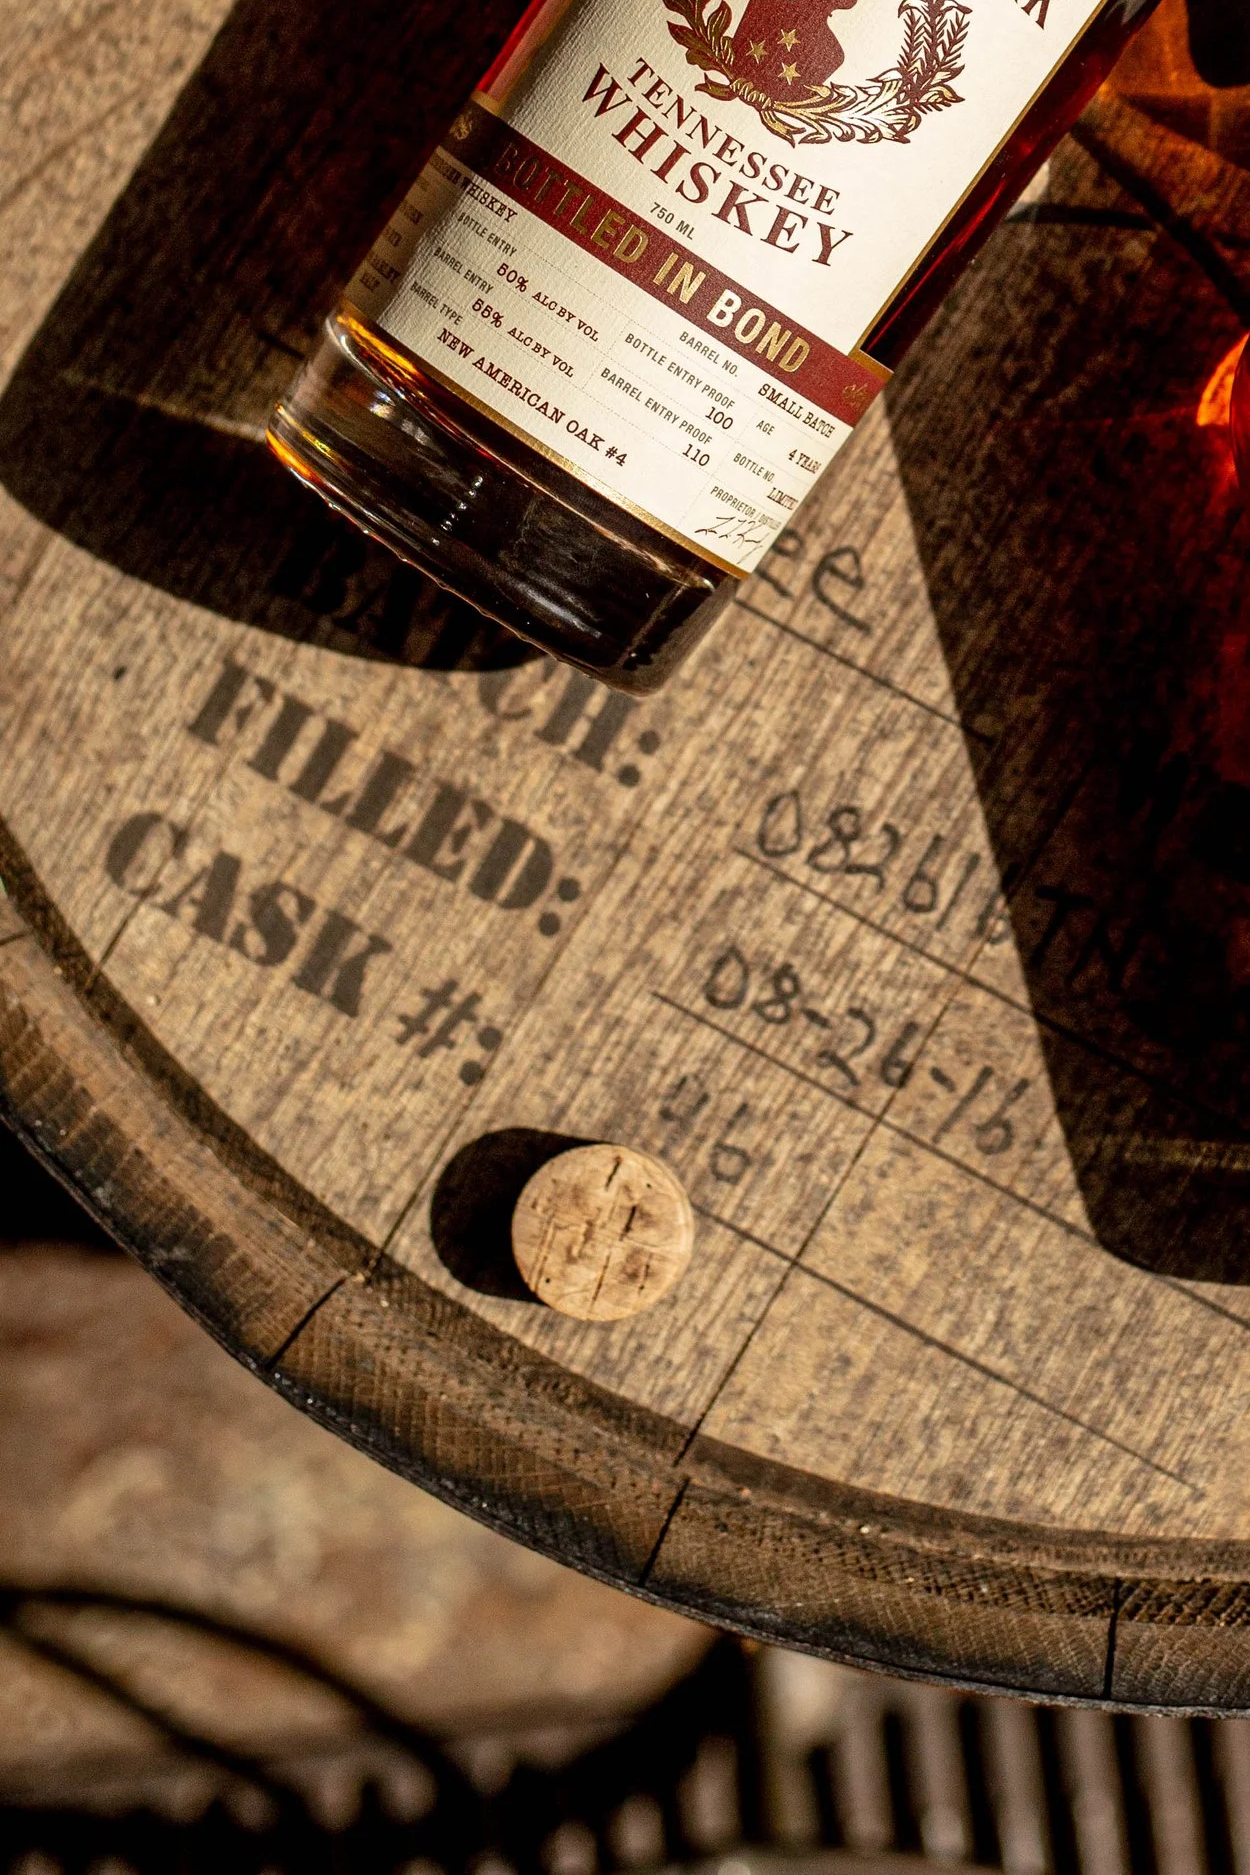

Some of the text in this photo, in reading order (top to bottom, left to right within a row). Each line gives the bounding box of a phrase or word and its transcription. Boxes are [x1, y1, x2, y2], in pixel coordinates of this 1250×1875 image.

[625, 56, 842, 217] TENNESSEE
[580, 66, 854, 269] WHISKEY
[460, 179, 518, 223] WHISKEY
[648, 201, 696, 241] 750 ML
[457, 211, 518, 258] BOTTLE ENTRY
[496, 139, 812, 374] BOTTLED IN BOND
[433, 246, 464, 275] BARREL
[464, 268, 494, 295] ENTRY
[410, 280, 440, 310] BARREL
[439, 302, 464, 326] TYPE
[496, 262, 600, 342] 50% ALC BY VOL
[471, 298, 575, 378] 55% ALC BY VOL
[679, 331, 739, 377] BARREL NO.
[624, 333, 735, 410] BOTTLE ENTRY PROOF
[437, 328, 628, 468] NEW AMERICAN OAK #4
[601, 366, 713, 445] BARREL ENTRY PROOF
[705, 406, 734, 431] 100
[758, 383, 803, 418] SMALL
[756, 419, 775, 436] AGE
[682, 443, 710, 467] 110
[733, 452, 764, 476] BOTTLE
[711, 486, 756, 519] PROPRIETOR
[186, 658, 584, 939] FILLED:
[102, 807, 395, 1019] CASK
